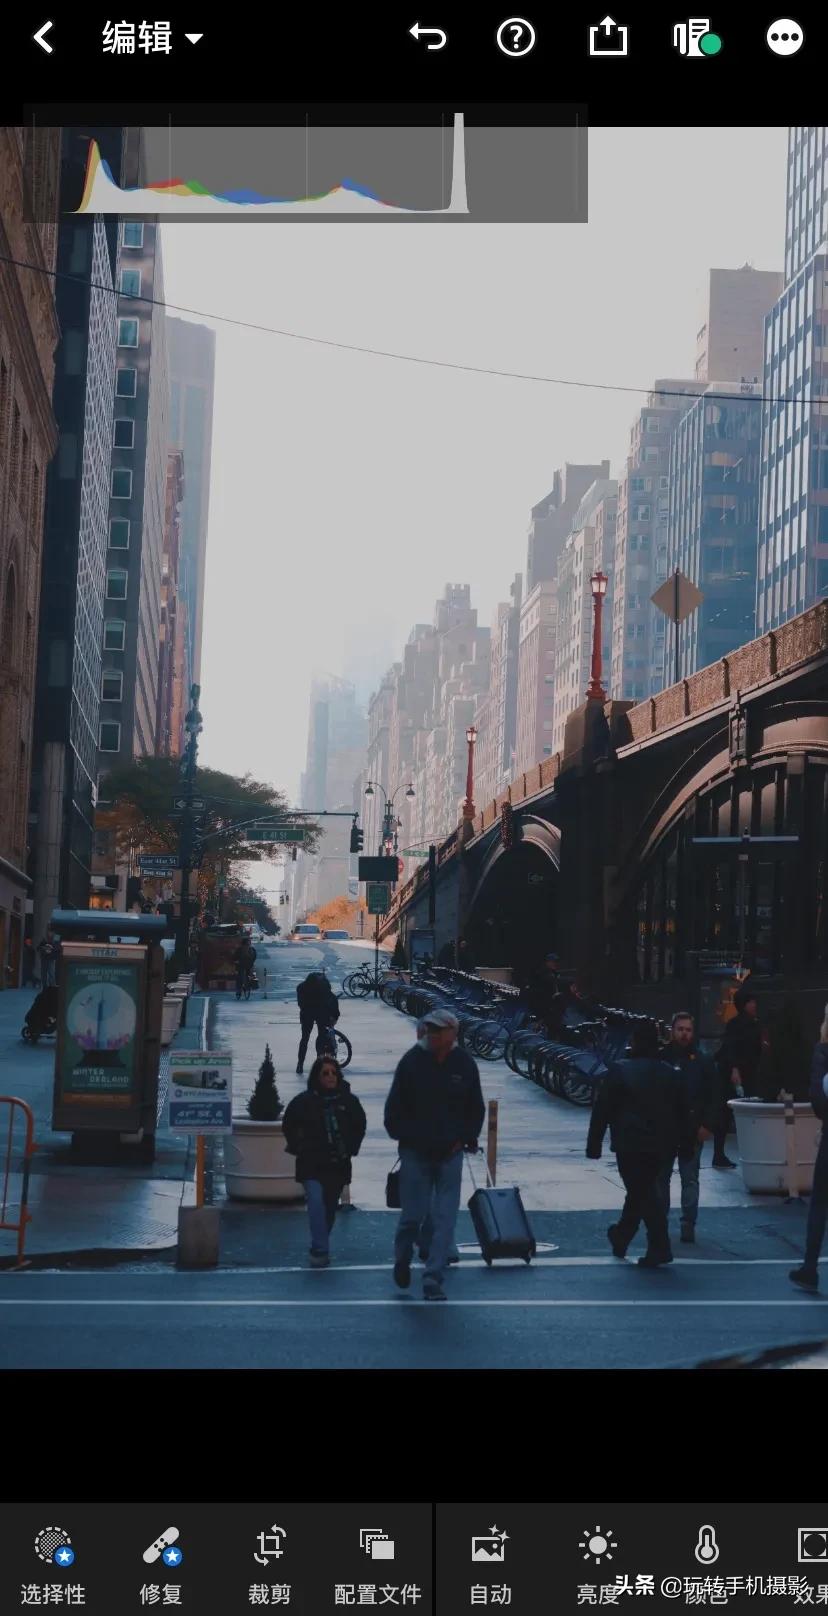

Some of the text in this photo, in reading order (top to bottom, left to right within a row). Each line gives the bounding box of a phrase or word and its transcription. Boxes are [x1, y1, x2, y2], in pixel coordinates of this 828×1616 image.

[102, 20, 172, 54] 编辑
[91, 949, 117, 957] TITAN
[72, 1068, 105, 1076] WINTER
[20, 1583, 86, 1605] 选择性
[139, 1583, 182, 1605] 修复
[248, 1583, 292, 1605] 裁剪
[334, 1583, 422, 1605] 配置文件
[470, 1583, 512, 1605] 自动
[577, 1583, 620, 1605] 亮度
